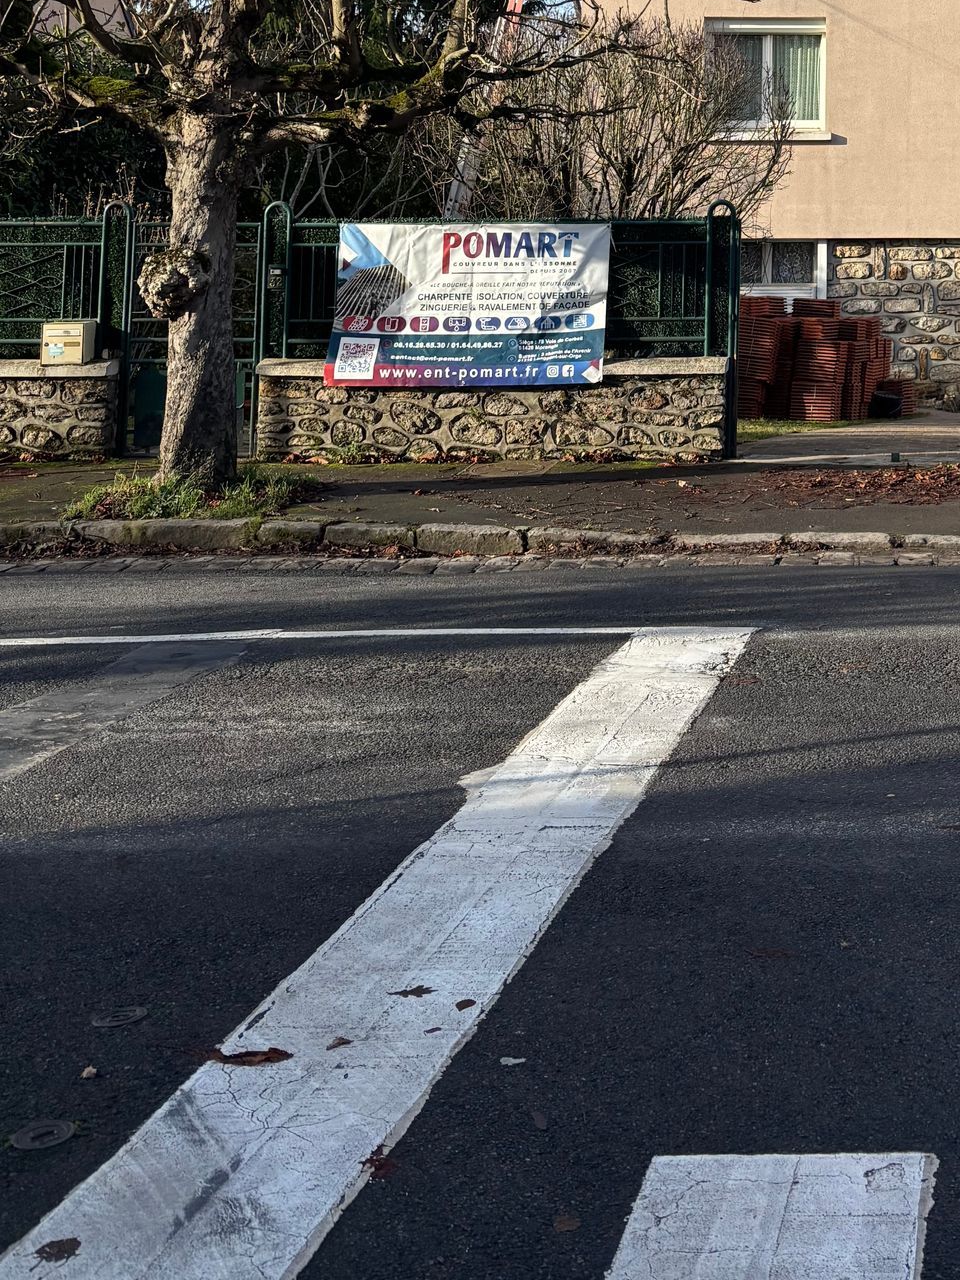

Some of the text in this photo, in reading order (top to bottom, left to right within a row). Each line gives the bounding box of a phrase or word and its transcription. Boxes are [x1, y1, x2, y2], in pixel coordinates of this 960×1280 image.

[442, 232, 579, 274] POMART
[476, 292, 525, 301] ISOLATION,
[420, 303, 468, 311] ZINGUERIE
[478, 303, 537, 311] RAVALEMENT
[553, 301, 590, 310] FAÇADE
[379, 366, 538, 380] www.ent-pomart.fr
